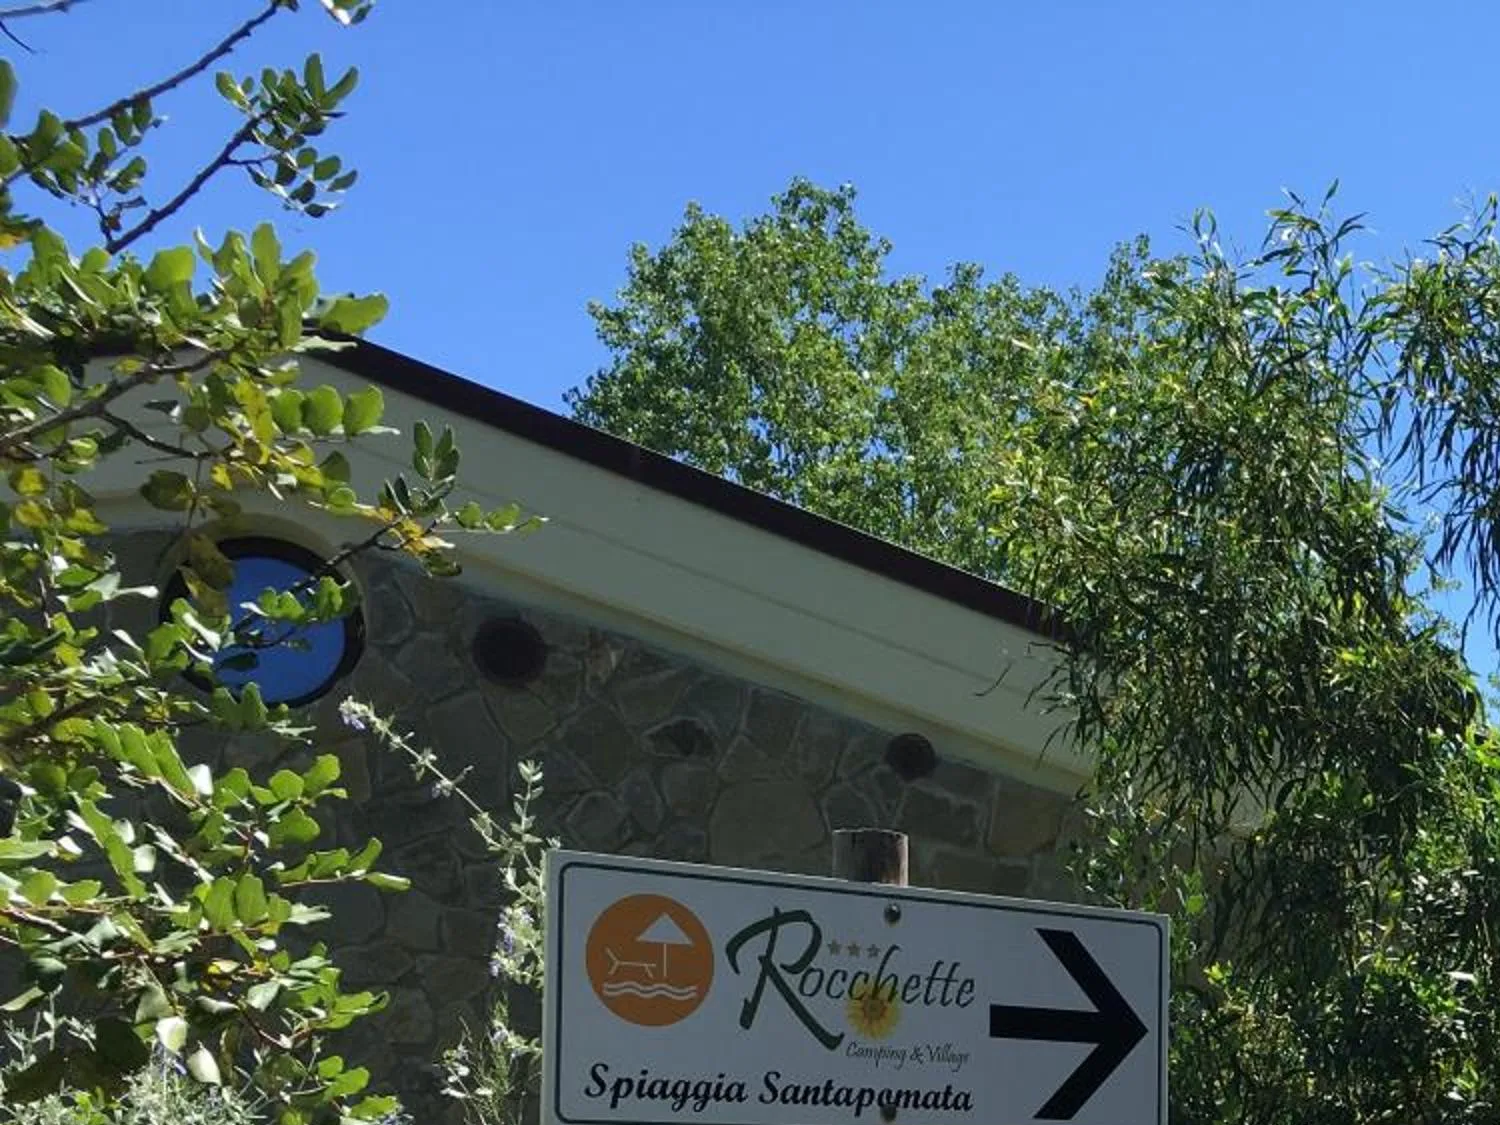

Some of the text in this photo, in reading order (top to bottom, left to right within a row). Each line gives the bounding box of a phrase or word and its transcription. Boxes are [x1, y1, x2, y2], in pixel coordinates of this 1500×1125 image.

[726, 906, 976, 1051] Rocchette
[846, 1041, 970, 1072] Camping & Village
[585, 1063, 973, 1117] Spiaggia Santapomata
